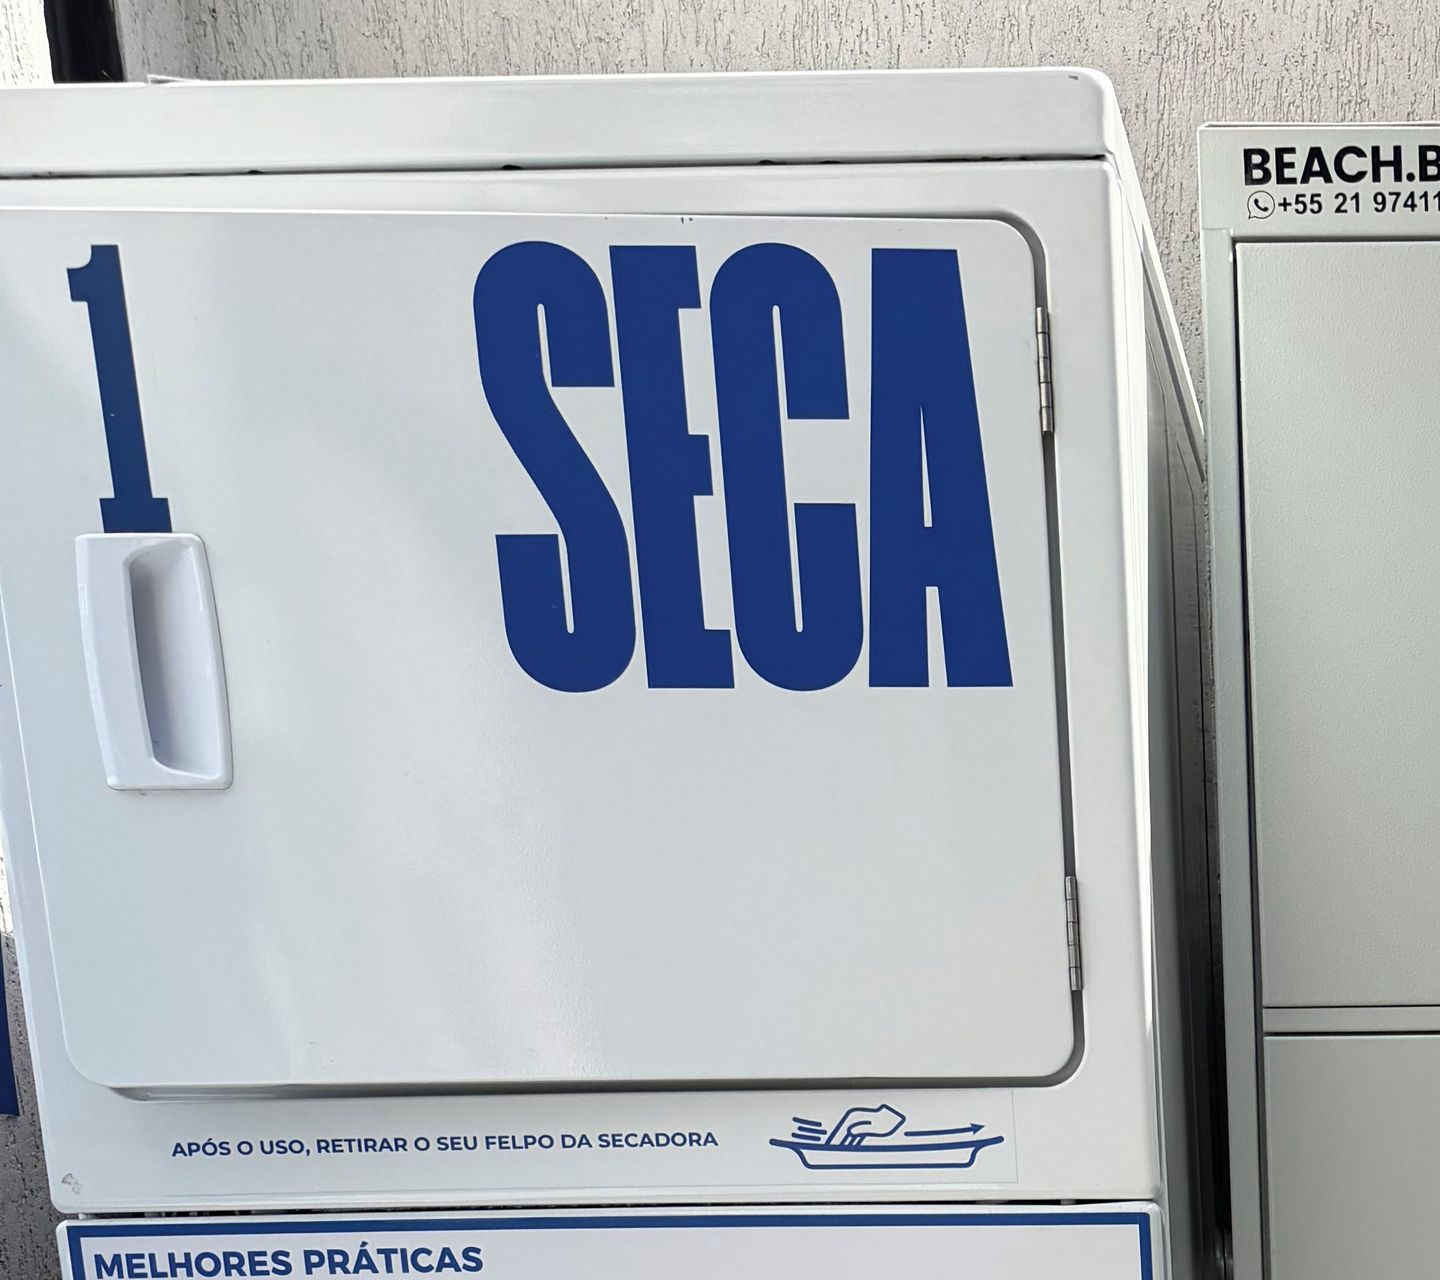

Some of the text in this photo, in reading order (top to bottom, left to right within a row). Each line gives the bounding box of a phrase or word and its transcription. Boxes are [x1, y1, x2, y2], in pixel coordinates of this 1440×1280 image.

[1278, 193, 1323, 215] +55
[1334, 191, 1360, 214] 21
[66, 243, 171, 534] 1
[472, 241, 1014, 694] SECA
[171, 1132, 719, 1157] APÓS O USO, RETIRAR O SEU FELPO DA SECADORA
[93, 1240, 483, 1280] MELHORES PRÁTICAS
